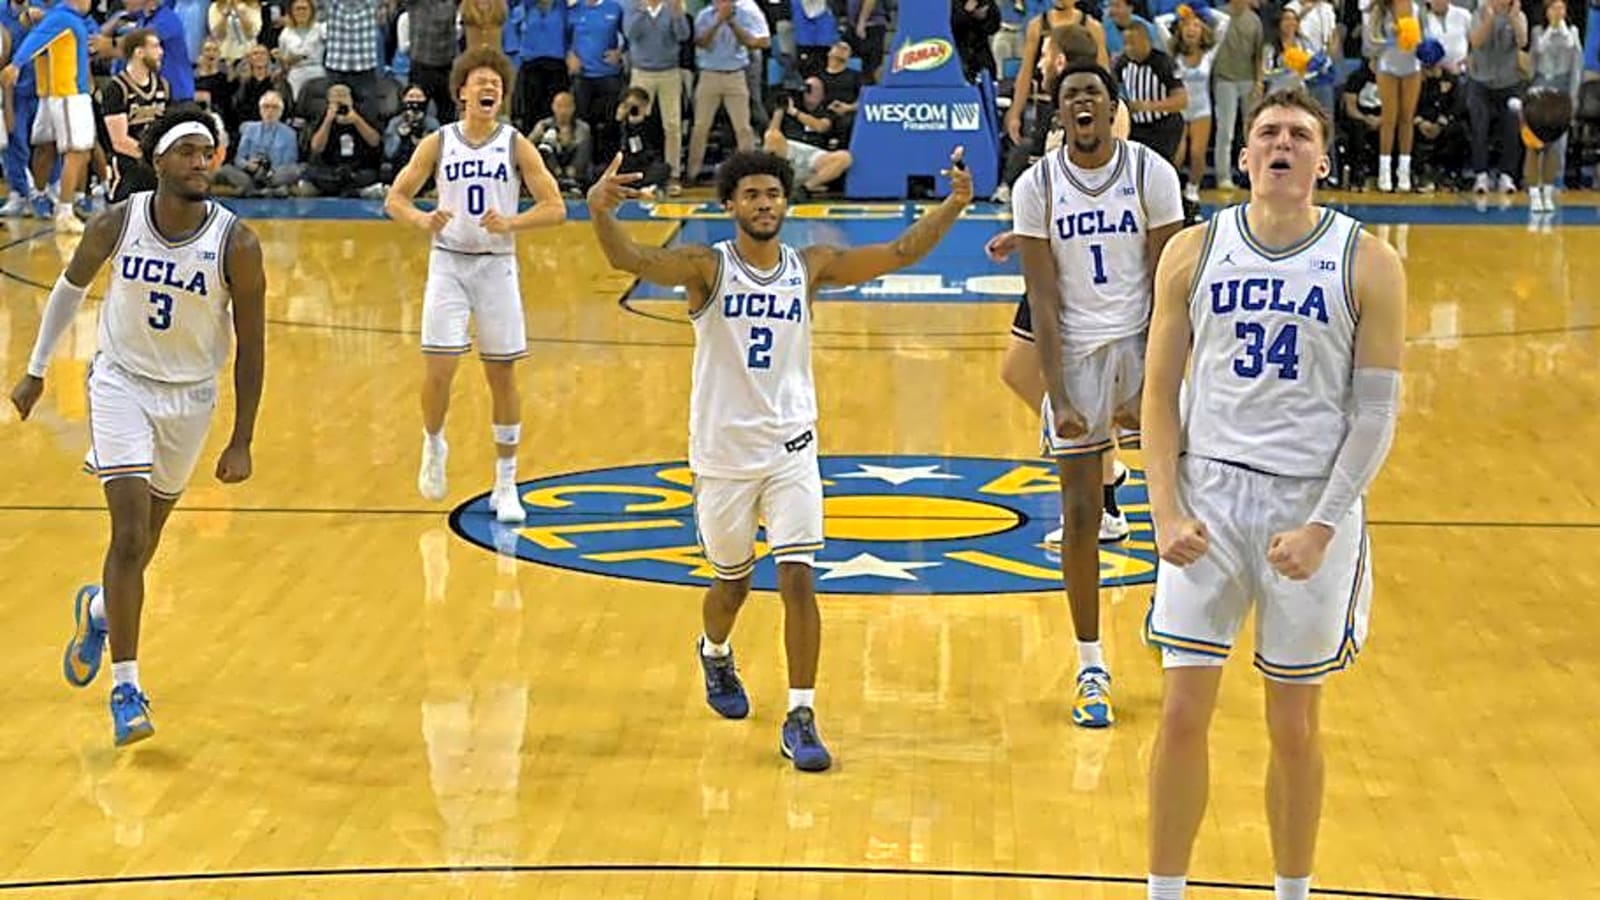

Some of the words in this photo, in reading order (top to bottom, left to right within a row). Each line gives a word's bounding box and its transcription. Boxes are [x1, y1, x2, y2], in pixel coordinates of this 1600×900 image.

[864, 103, 948, 122] WESCOM
[903, 120, 948, 131] Financial
[445, 160, 508, 182] UCLA
[467, 184, 485, 215] 0
[1056, 209, 1139, 240] UCLA
[122, 255, 208, 297] UCLA
[1089, 244, 1108, 284] 1
[148, 290, 174, 331] 3
[724, 292, 802, 323] UCLA
[1210, 278, 1329, 324] UCLA
[747, 326, 774, 370] 2
[1233, 321, 1299, 380] 34
